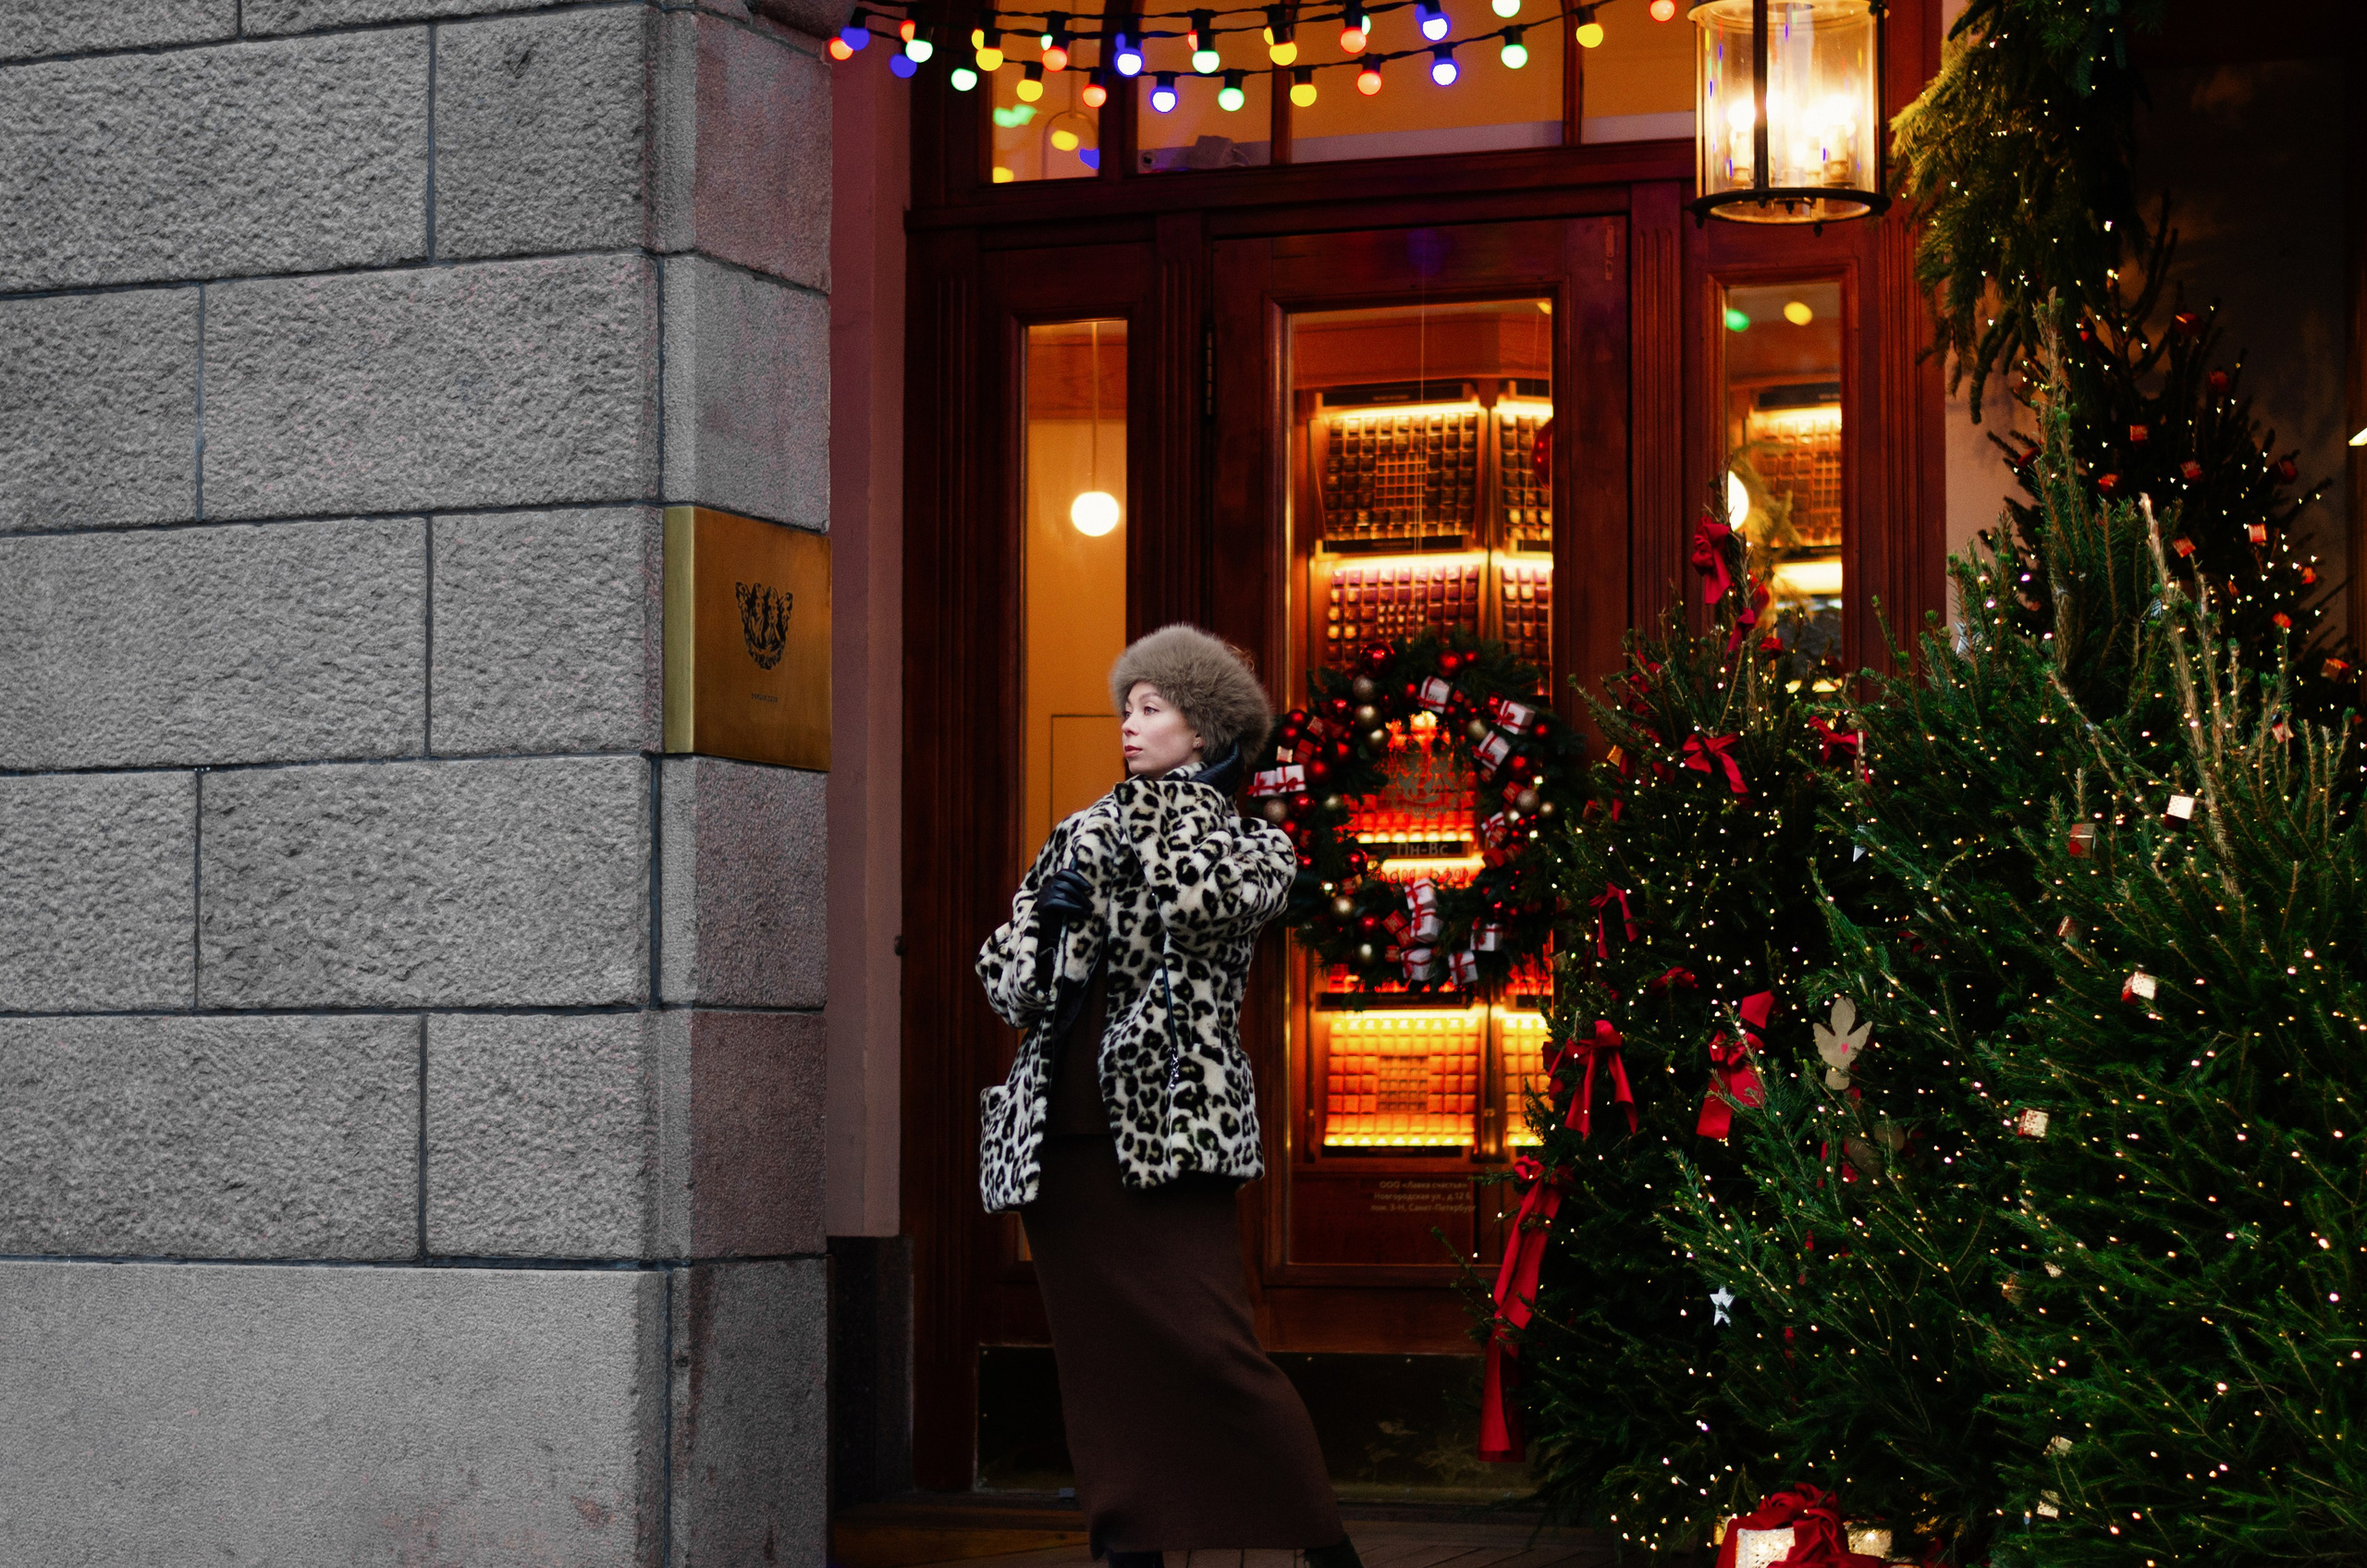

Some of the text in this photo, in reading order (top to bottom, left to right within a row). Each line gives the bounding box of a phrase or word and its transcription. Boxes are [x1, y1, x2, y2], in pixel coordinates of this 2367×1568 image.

[1396, 842, 1448, 855] Пн-Вс
[1380, 1181, 1400, 1189] ООО
[1374, 1193, 1430, 1201] Новгородская
[1408, 1203, 1476, 1214] Санкт-Петербург
